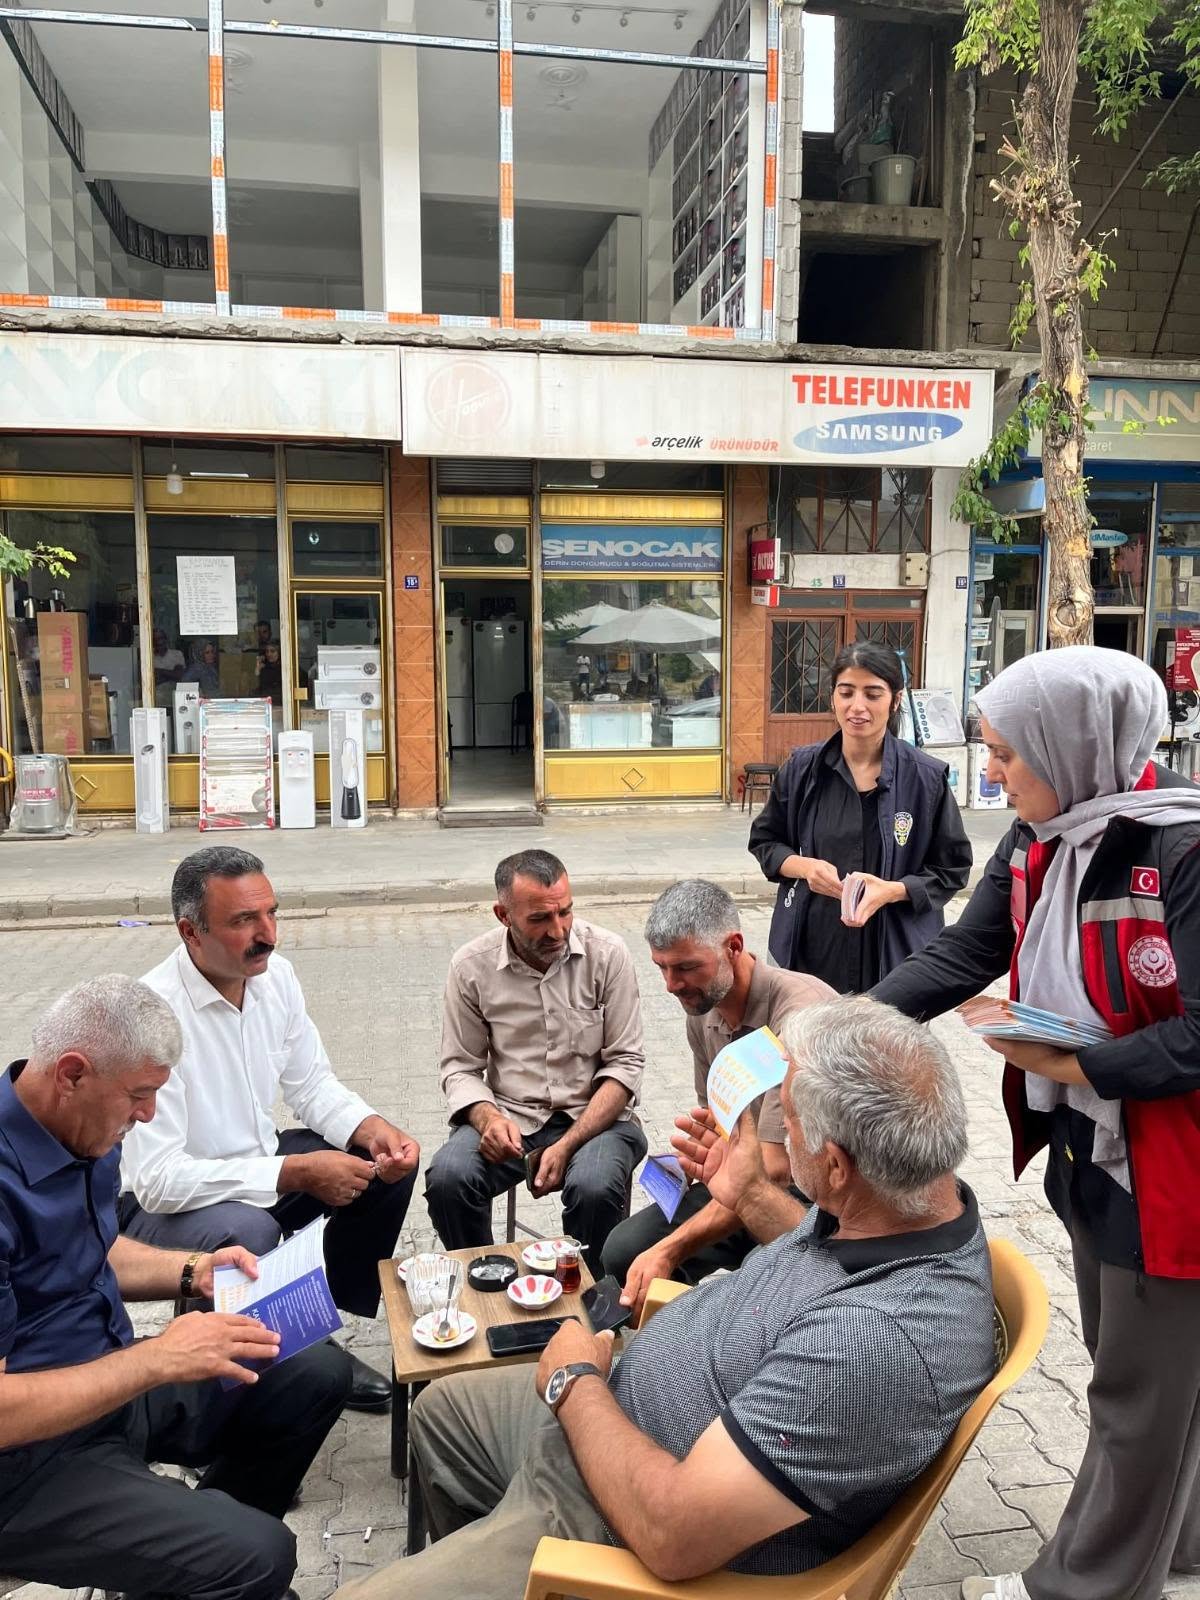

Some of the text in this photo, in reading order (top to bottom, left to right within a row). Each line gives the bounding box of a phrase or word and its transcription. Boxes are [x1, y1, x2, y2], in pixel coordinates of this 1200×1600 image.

[792, 375, 971, 409] TELEFUNKEN
[816, 422, 943, 443] SAMSUNG
[651, 435, 779, 452] arçelik ÜRÜNÜDÜR
[1084, 441, 1112, 452] caret
[757, 552, 774, 570] ALTUS
[63, 633, 74, 673] ALTUS
